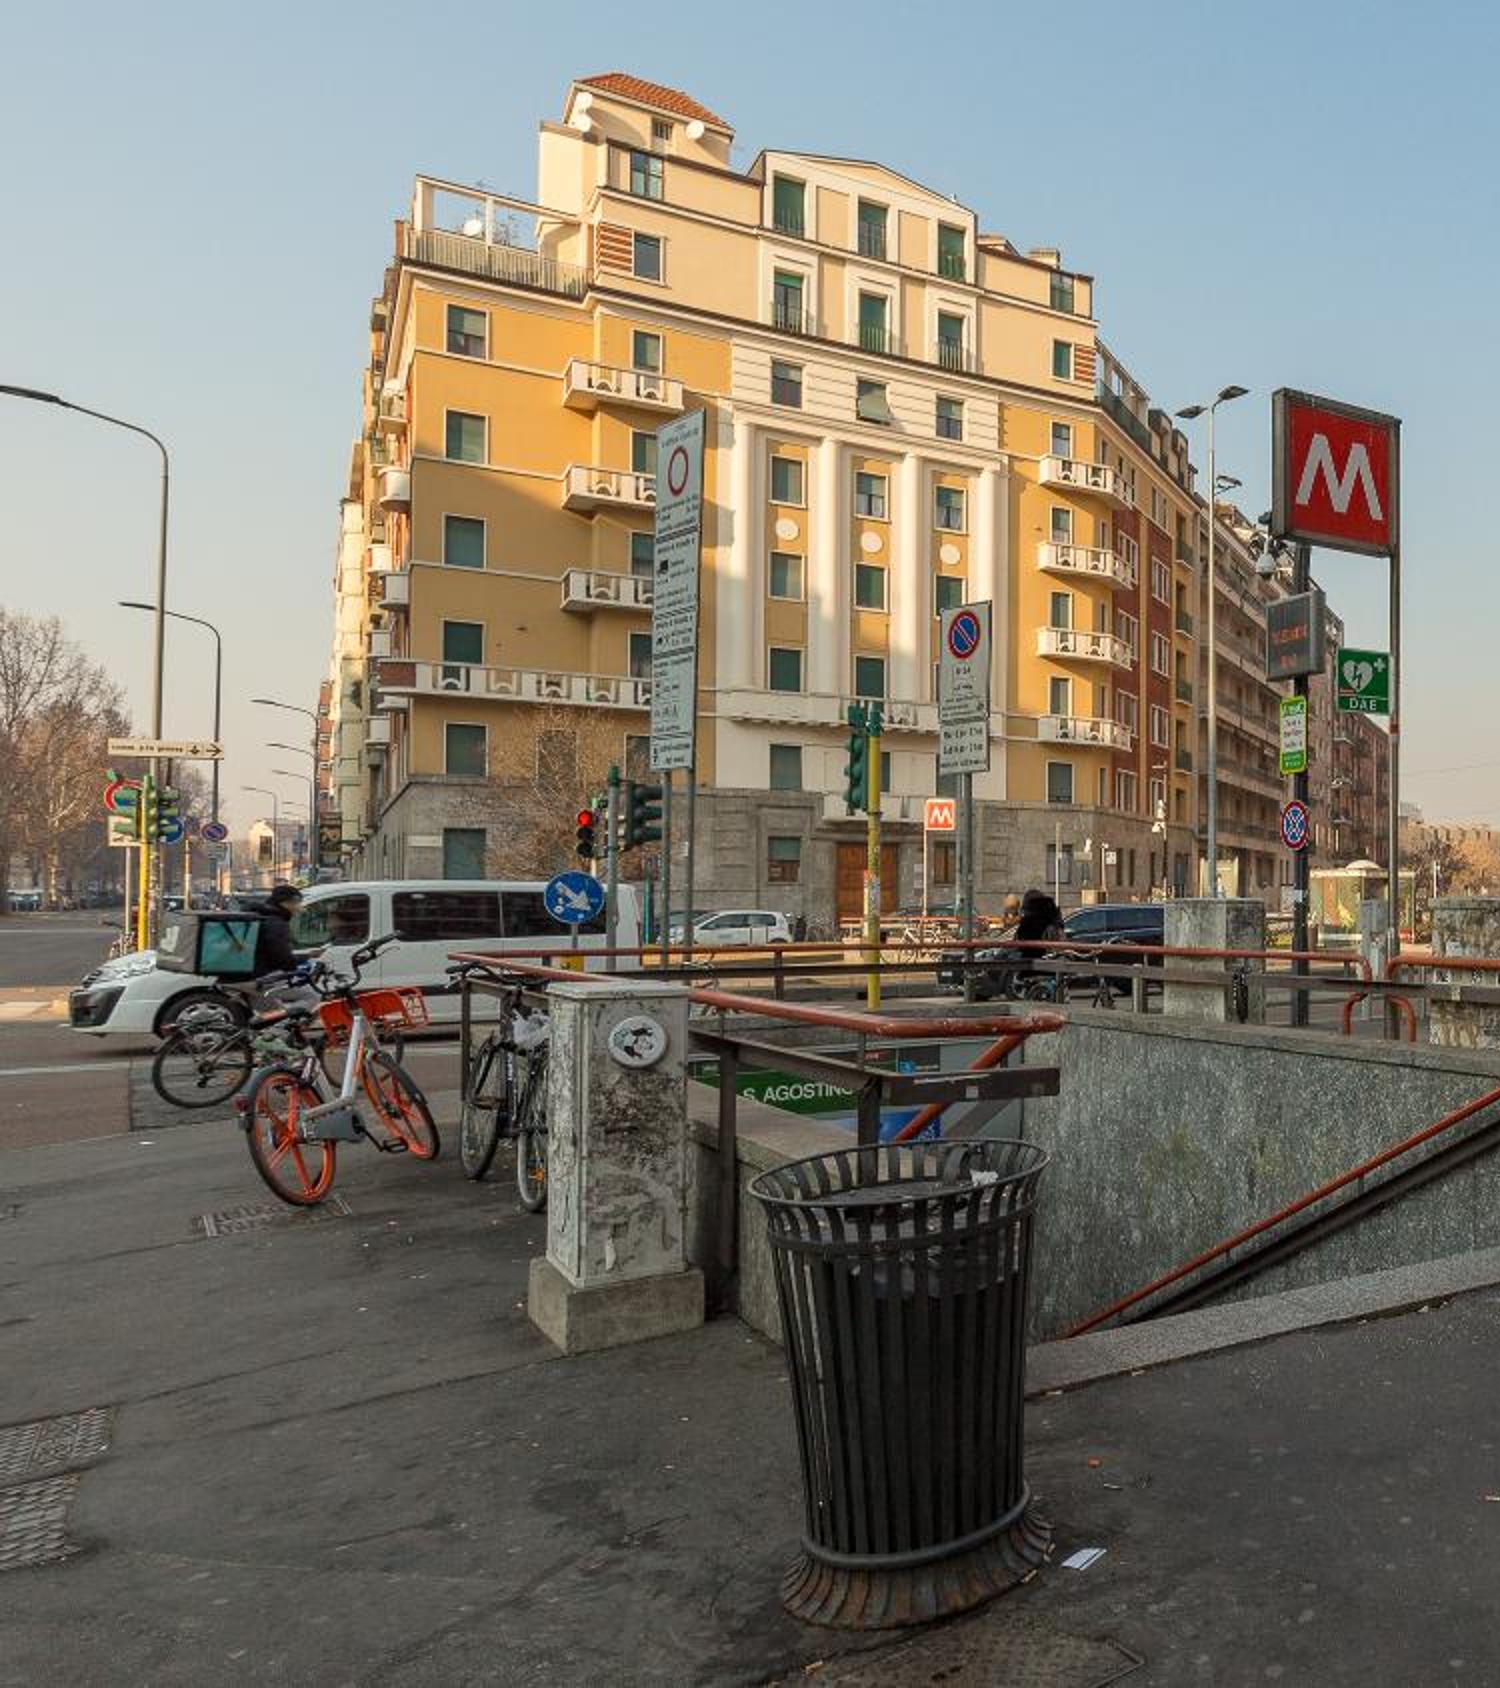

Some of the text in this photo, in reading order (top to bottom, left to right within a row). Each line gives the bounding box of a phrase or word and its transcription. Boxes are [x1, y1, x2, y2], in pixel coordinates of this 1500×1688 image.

[1296, 433, 1383, 521] M
[1349, 698, 1377, 711] DAE
[930, 805, 953, 824] M
